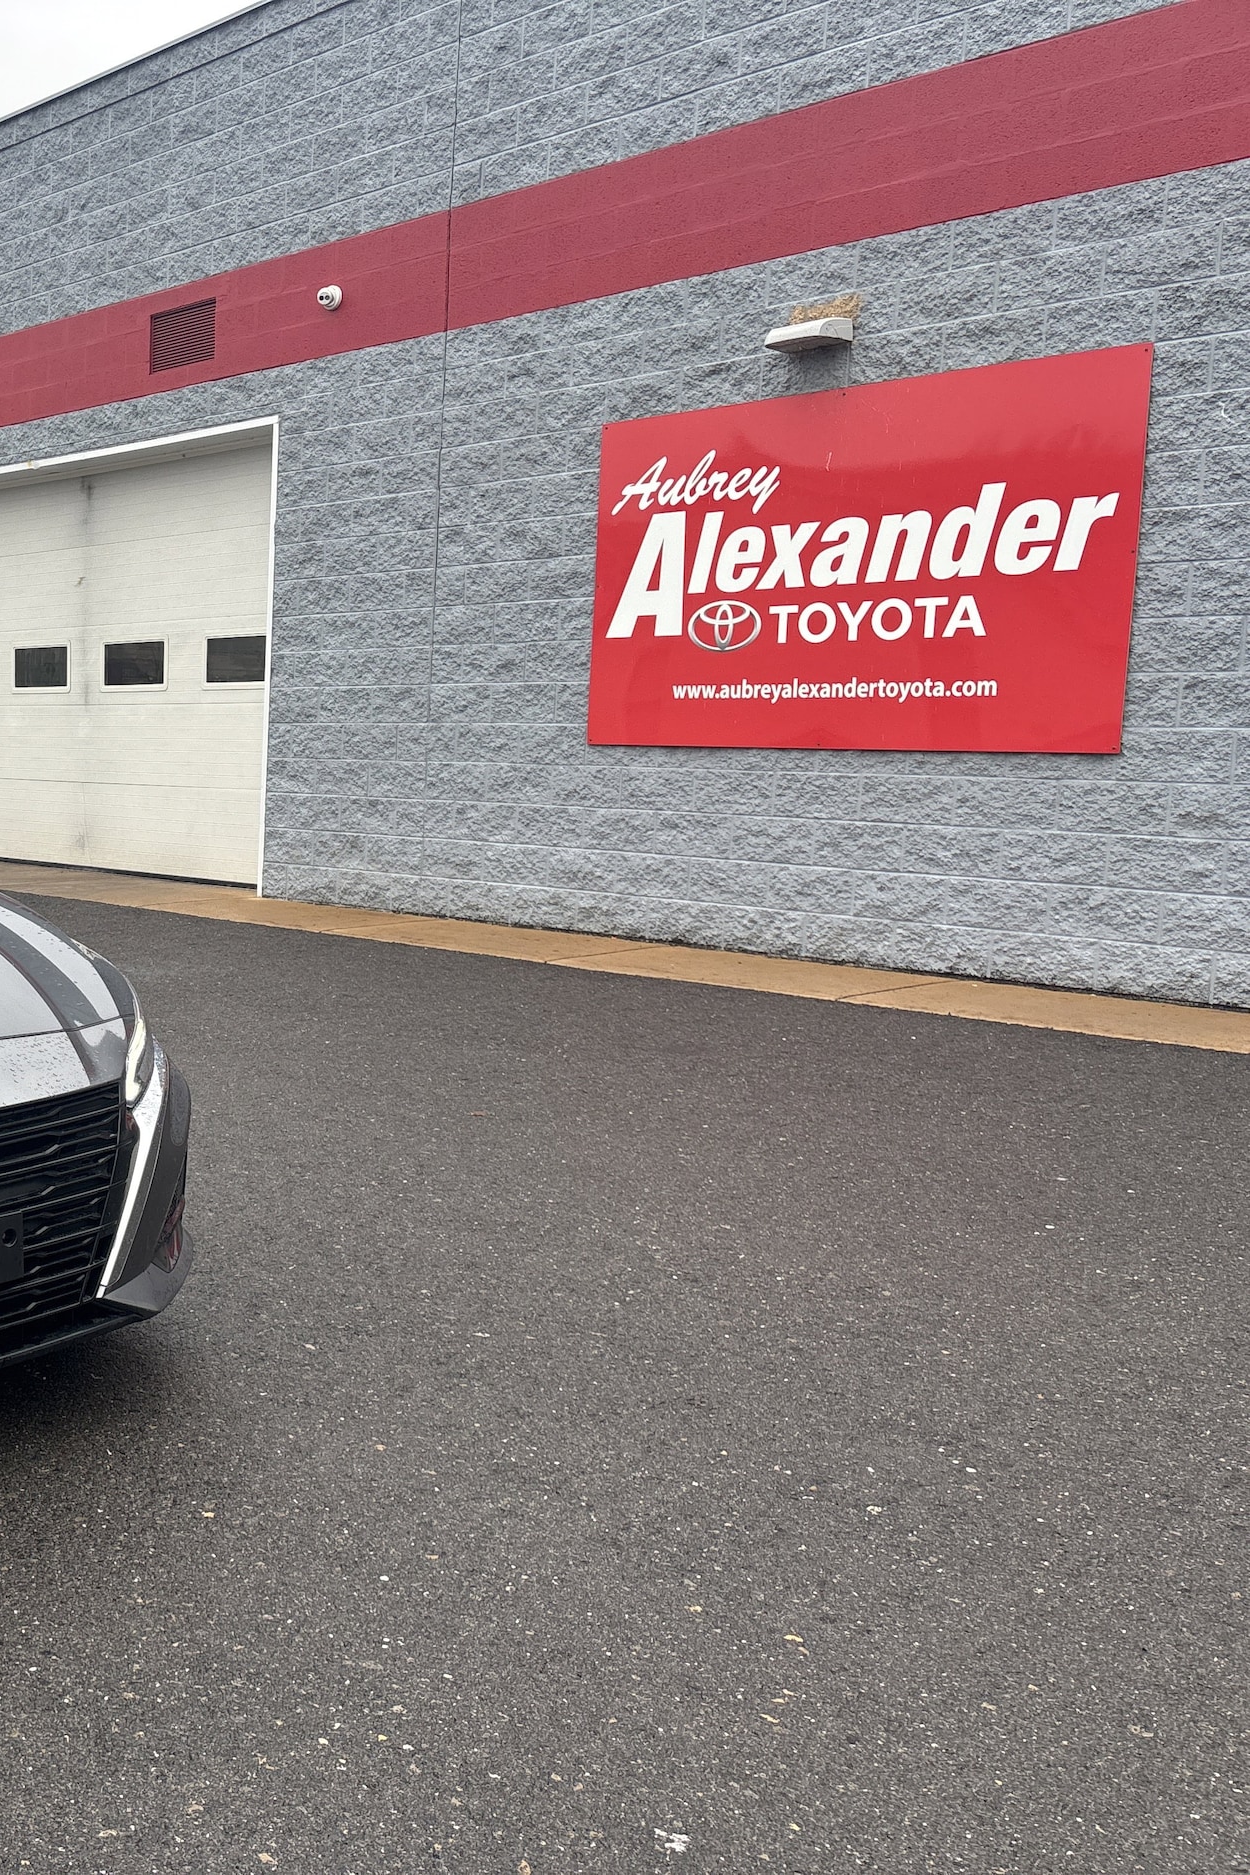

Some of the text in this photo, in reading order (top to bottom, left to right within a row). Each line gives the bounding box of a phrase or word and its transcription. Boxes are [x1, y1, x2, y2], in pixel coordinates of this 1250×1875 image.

[612, 450, 780, 515] Aubrey
[606, 482, 1119, 638] Alexander
[769, 596, 987, 644] TOYOTA
[673, 677, 997, 704] www.aubreyalexandertoyota.com
